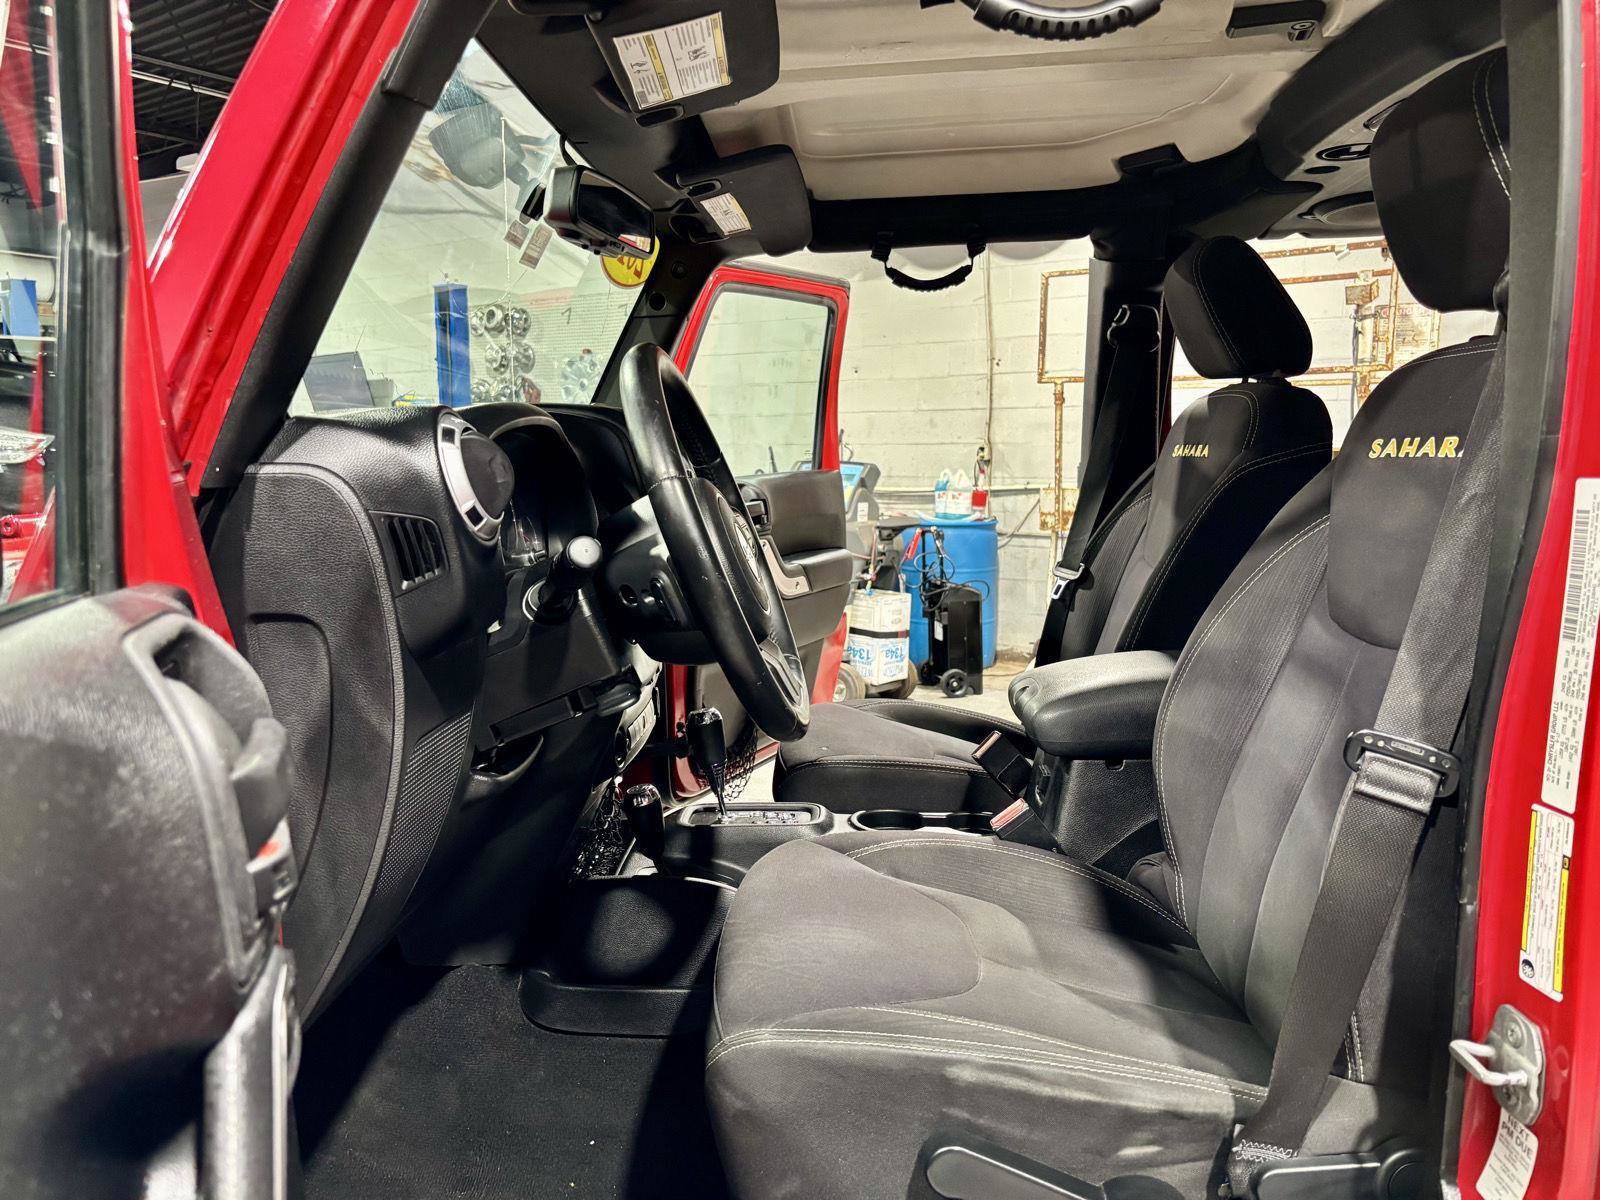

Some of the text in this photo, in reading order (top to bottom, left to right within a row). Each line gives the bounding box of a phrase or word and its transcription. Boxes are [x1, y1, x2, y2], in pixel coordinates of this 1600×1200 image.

[1172, 444, 1209, 458] SAHARA
[1368, 436, 1464, 459] SAHAR
[1547, 735, 1556, 765] CHRYSLER
[1501, 1121, 1534, 1158] PM DUE
